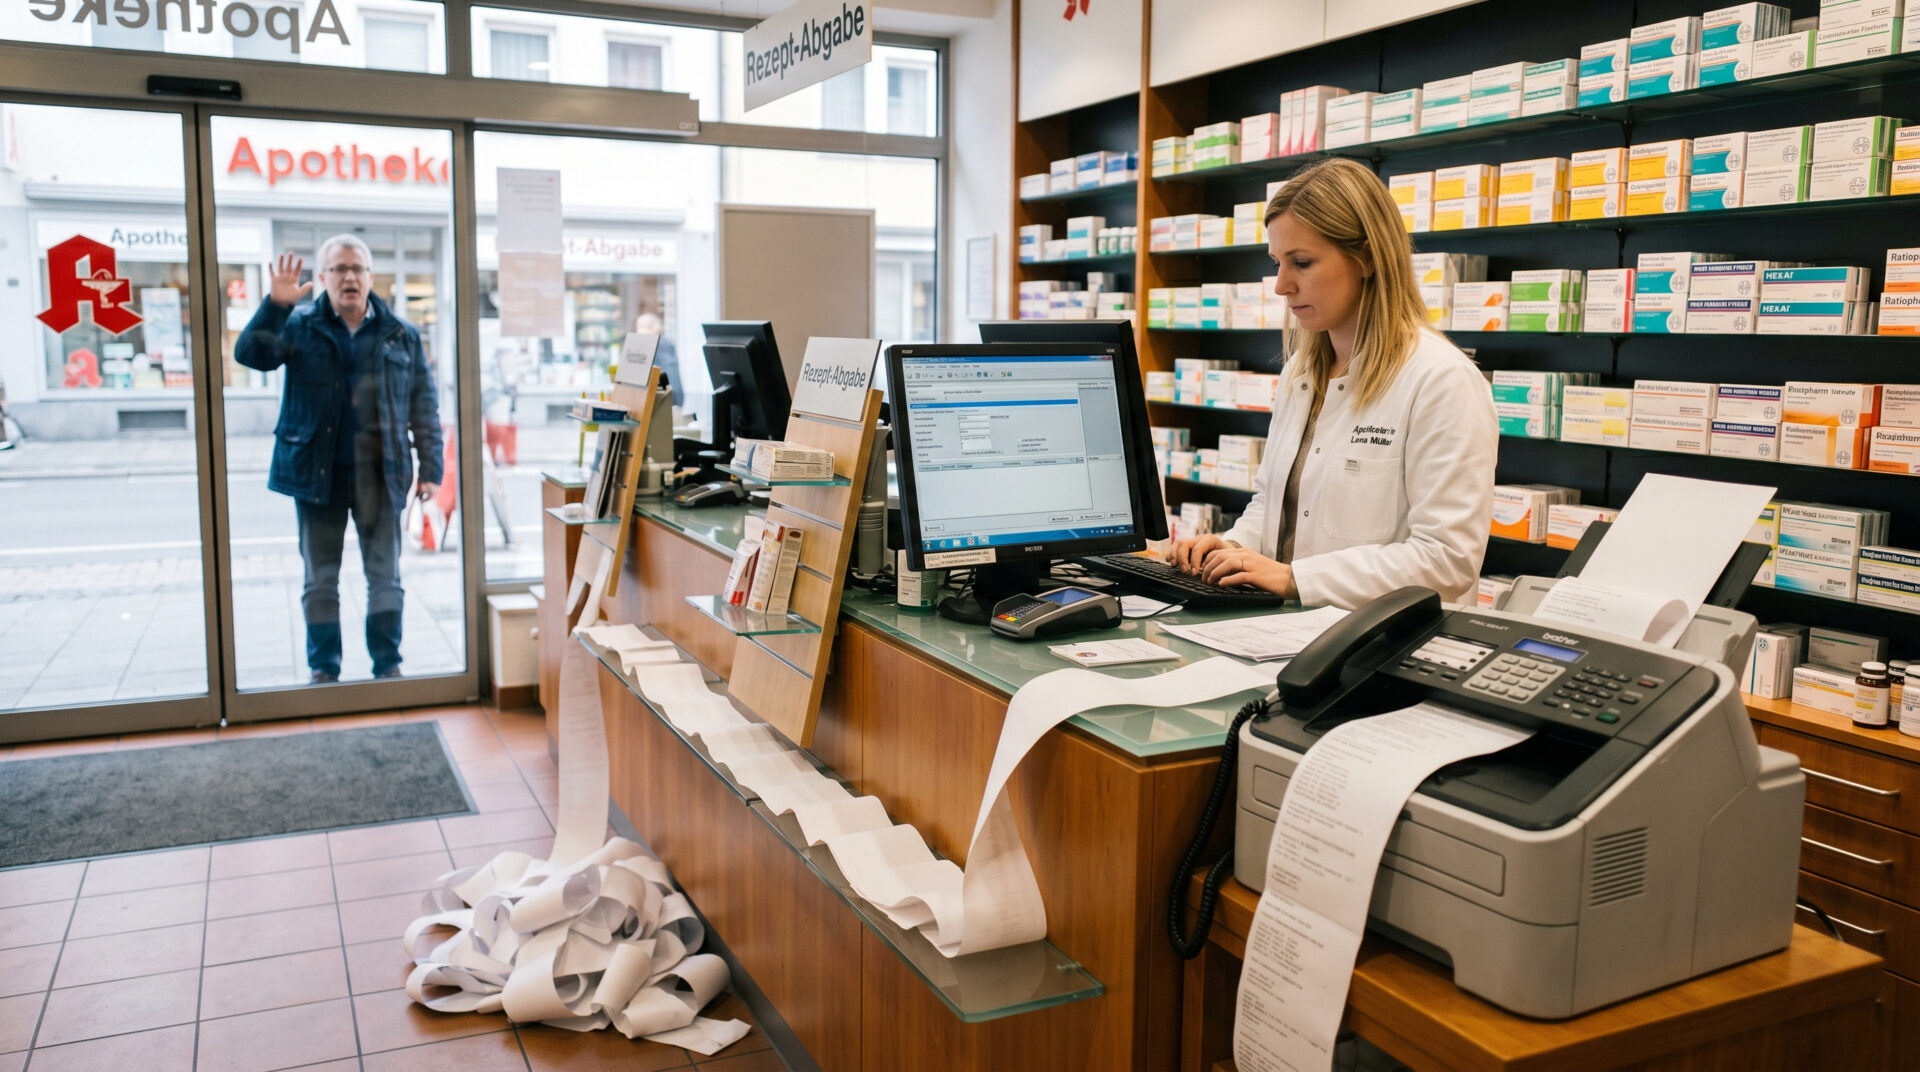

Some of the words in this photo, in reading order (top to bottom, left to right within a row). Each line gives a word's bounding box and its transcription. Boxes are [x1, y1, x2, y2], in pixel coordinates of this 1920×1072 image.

[747, 3, 865, 86] Rezept-Abgabe
[1885, 296, 1920, 306] Ratioph
[802, 363, 867, 391] Rezept-Abgabe
[1350, 436, 1368, 444] Lena
[1541, 632, 1580, 646] brother
